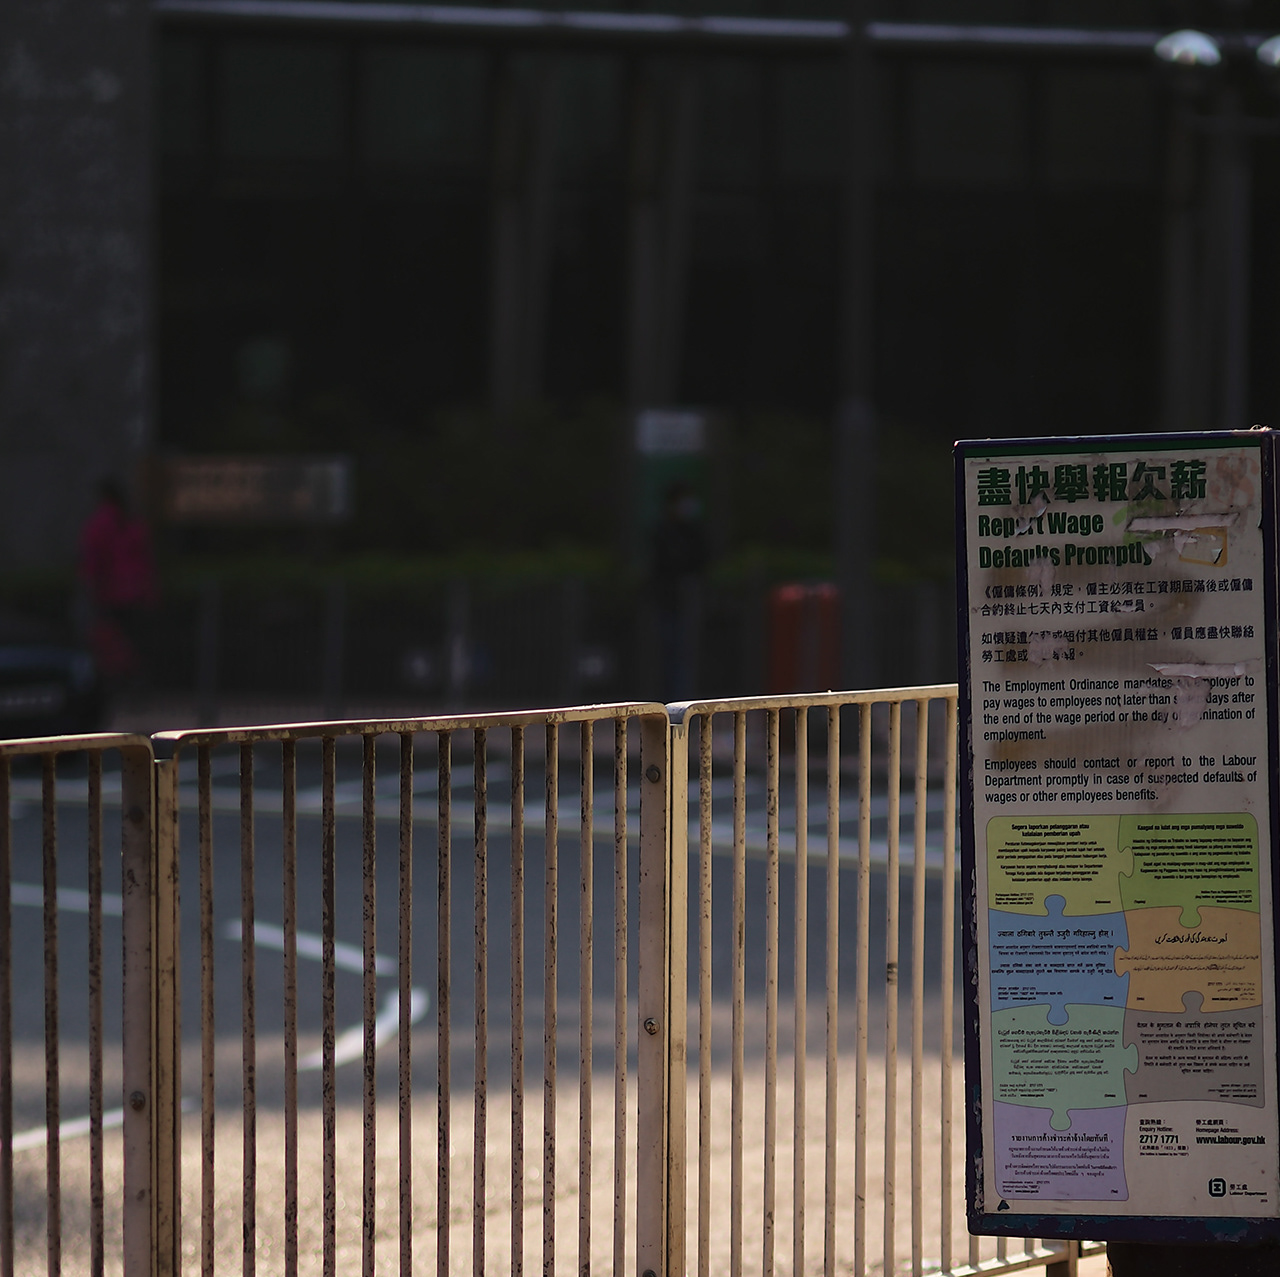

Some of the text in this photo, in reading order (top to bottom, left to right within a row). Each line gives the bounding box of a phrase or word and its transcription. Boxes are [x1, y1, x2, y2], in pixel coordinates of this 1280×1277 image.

[978, 460, 1206, 506] 盡快舉報欠薪
[1048, 512, 1104, 535] Wage
[983, 681, 1000, 692] The
[1006, 680, 1065, 693] Employment
[1070, 679, 1119, 690] Ordinance
[1245, 675, 1254, 686] to
[984, 700, 1000, 710] pay
[1004, 699, 1034, 710] wages
[1038, 697, 1047, 707] to
[1050, 696, 1102, 708] employees
[1105, 695, 1121, 707] not
[1124, 693, 1146, 705] later
[1149, 694, 1170, 704] than
[1232, 692, 1254, 703] after
[984, 714, 998, 724] the
[1003, 713, 1020, 724] end
[1024, 712, 1033, 723] of
[1037, 712, 1051, 723] the
[1055, 714, 1081, 725] wage
[1085, 711, 1115, 724] period
[1119, 713, 1128, 722] or
[1132, 711, 1148, 721] the
[1151, 710, 1168, 723] day
[1246, 708, 1255, 719] of
[984, 729, 1046, 742] employment.
[985, 755, 1256, 770] Employees should contact or report to the Labour
[985, 771, 1256, 788] Department promptly in case of suspected defaults of
[985, 789, 1158, 804] wages or other employees benefits.
[1140, 1135, 1179, 1143] 2717 1771
[1196, 1135, 1265, 1145] www.labour.gov.hk
